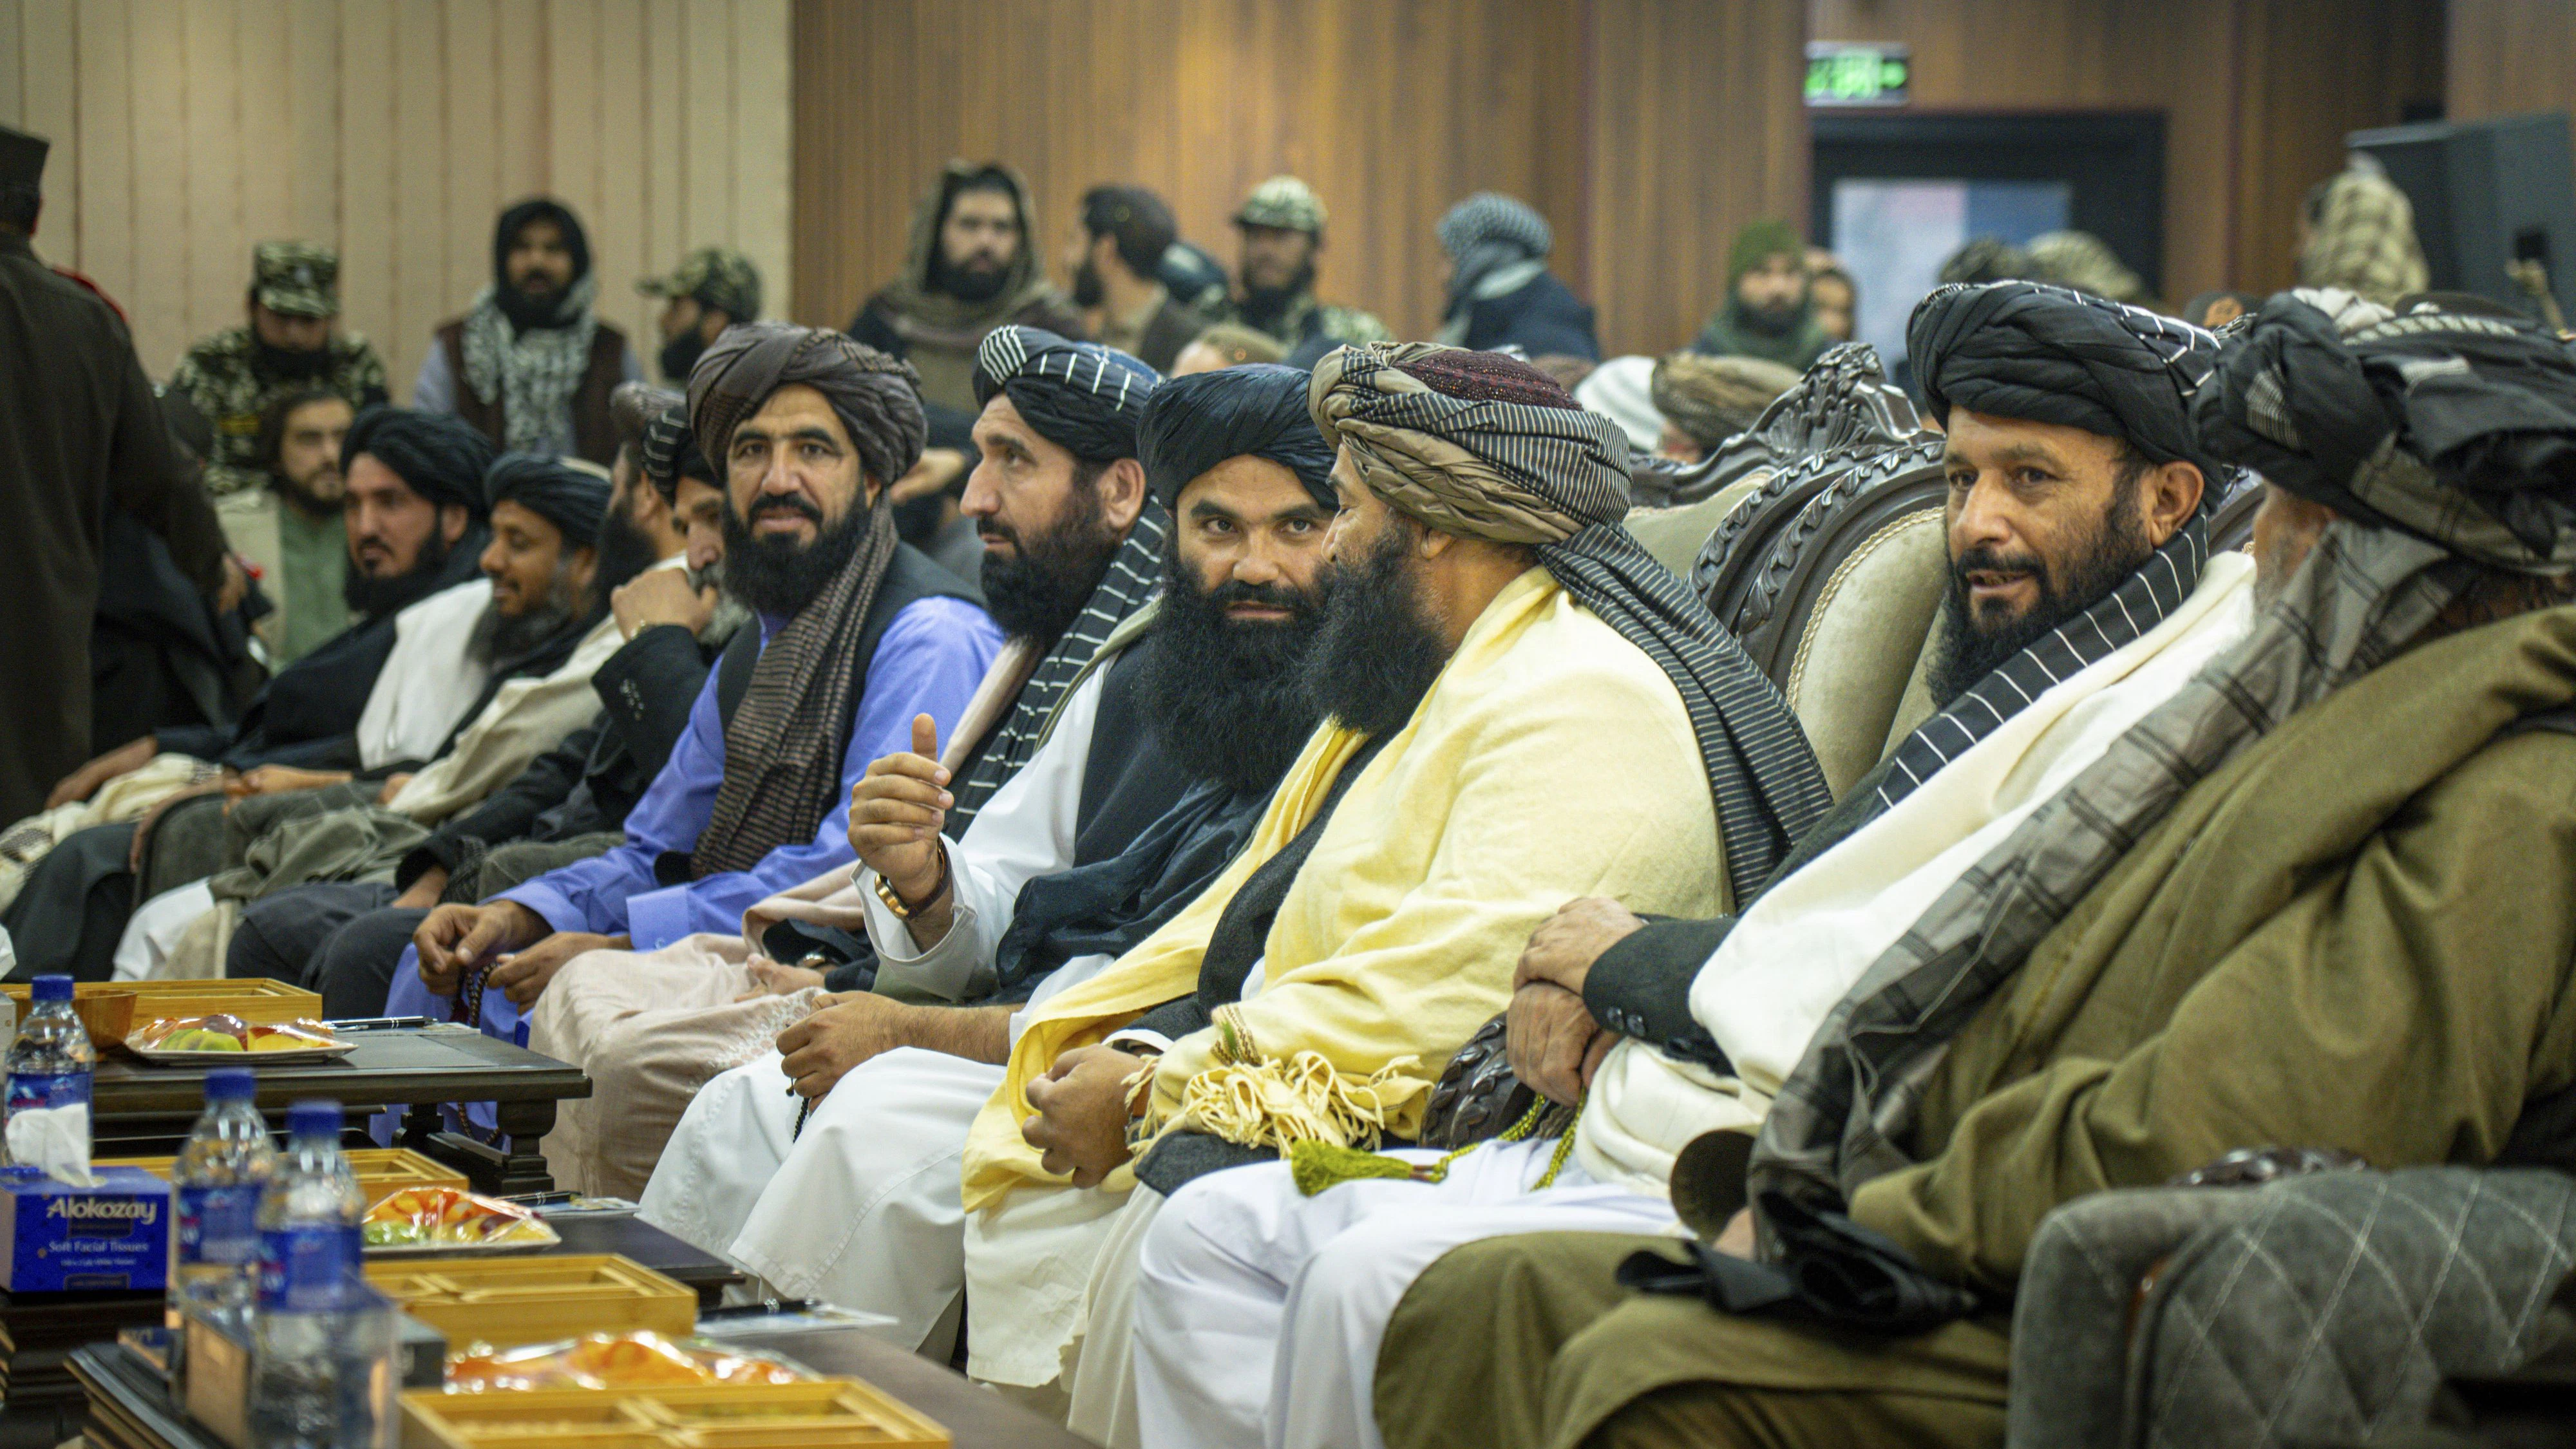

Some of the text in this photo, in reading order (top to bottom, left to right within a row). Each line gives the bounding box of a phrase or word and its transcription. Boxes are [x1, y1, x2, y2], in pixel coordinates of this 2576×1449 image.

[46, 1197, 157, 1225] Alokozay
[48, 1241, 149, 1253] Soft Facial Tissues
